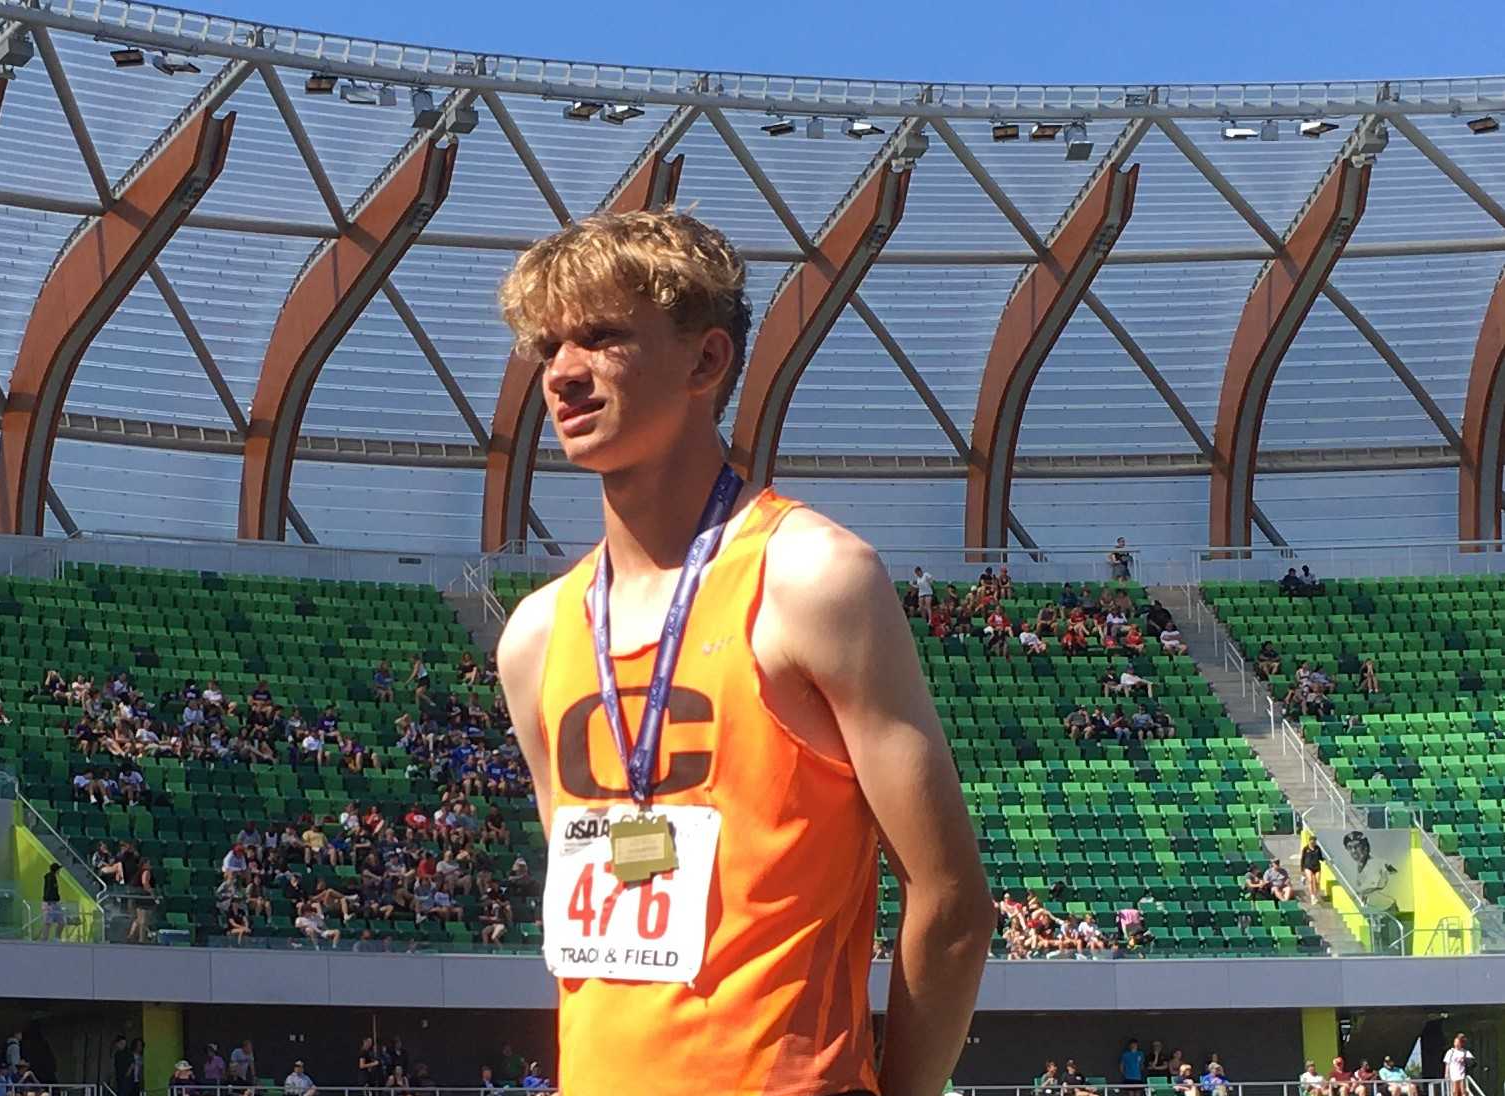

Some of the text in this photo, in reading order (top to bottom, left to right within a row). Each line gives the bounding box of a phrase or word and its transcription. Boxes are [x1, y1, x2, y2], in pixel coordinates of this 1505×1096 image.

[557, 686, 715, 800] C
[565, 818, 611, 840] OSAA
[568, 862, 671, 940] 476
[604, 947, 617, 963] &
[625, 949, 679, 967] FIELD
